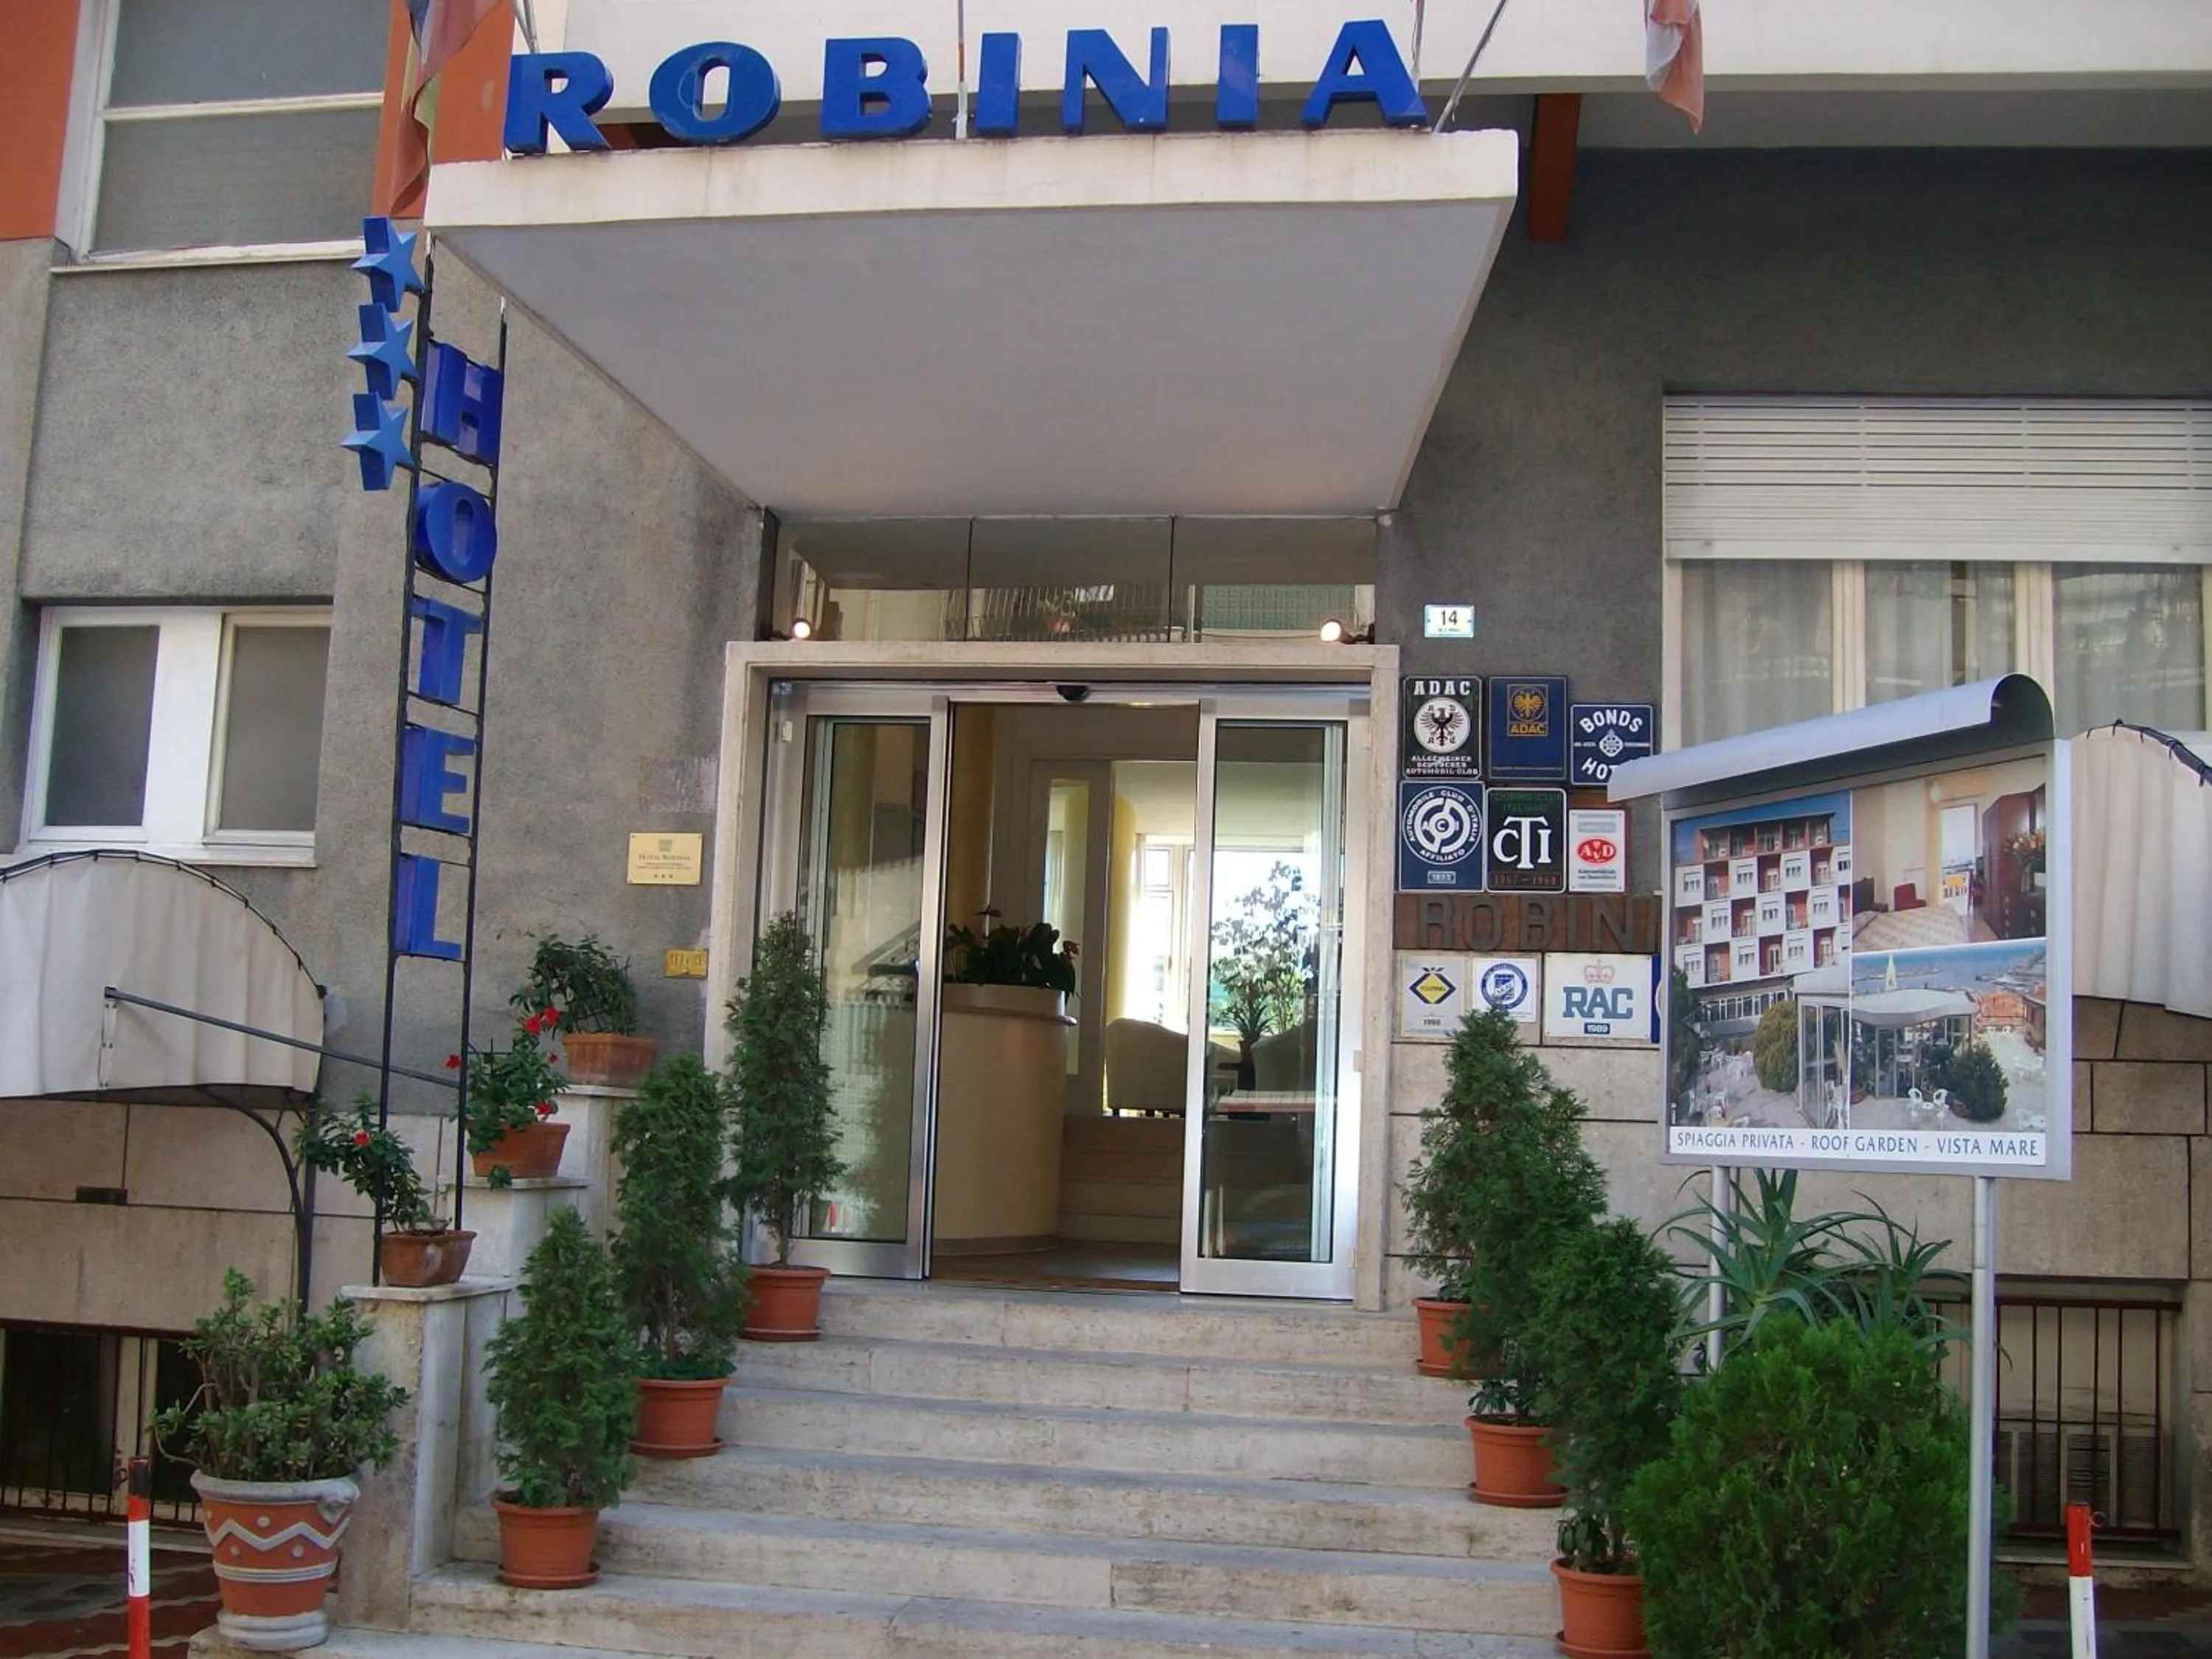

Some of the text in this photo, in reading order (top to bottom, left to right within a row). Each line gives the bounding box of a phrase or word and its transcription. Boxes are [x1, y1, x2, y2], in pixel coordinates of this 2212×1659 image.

[505, 20, 1427, 154] ROBINIA
[1441, 609, 1458, 625] 14
[394, 341, 503, 961] HOTEL
[1413, 681, 1471, 695] ADAC
[1510, 724, 1545, 734] ADAC
[1579, 709, 1643, 733] BONDS
[1581, 757, 1618, 780] HOT
[1406, 792, 1435, 841] AUTOMOBILE
[1440, 790, 1465, 802] CLUB
[1493, 815, 1552, 869] CTI
[1420, 849, 1465, 862] AFFILIATO
[1418, 894, 1662, 953] ROBIN
[1562, 986, 1634, 1020] RAC
[1586, 1023, 1609, 1032] 1989
[1677, 1132, 1736, 1148] SPIAGGIA
[1742, 1135, 1795, 1150] PRIVATA
[1811, 1137, 1849, 1151] ROOF
[1854, 1138, 1919, 1153] GARDEN
[1937, 1139, 1982, 1155] VISTA
[1989, 1140, 2039, 1157] MARE
